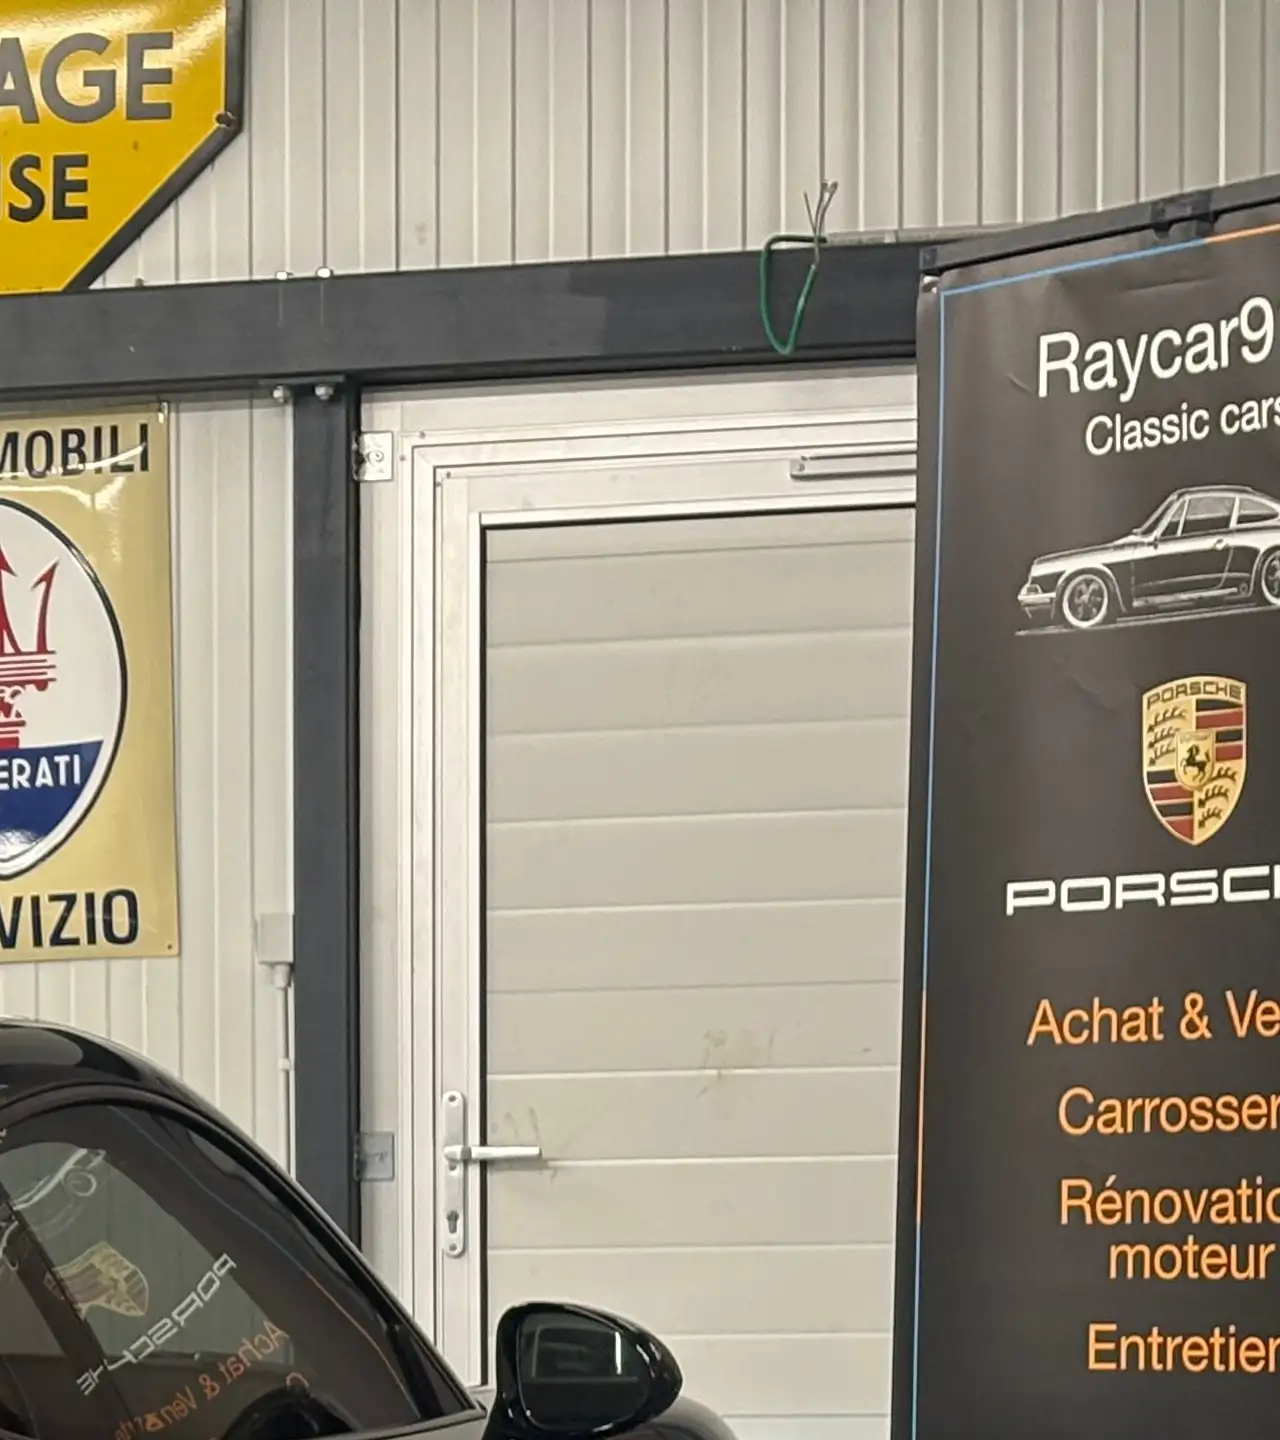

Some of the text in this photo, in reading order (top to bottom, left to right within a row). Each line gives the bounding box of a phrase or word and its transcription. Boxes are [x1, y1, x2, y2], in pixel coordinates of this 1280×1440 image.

[1086, 404, 1210, 456] Classic
[1147, 681, 1241, 710] PORSCHE
[1007, 864, 1280, 916] PORSC
[1027, 997, 1163, 1046] Achat
[1180, 992, 1212, 1040] &
[1110, 1235, 1276, 1280] moteur
